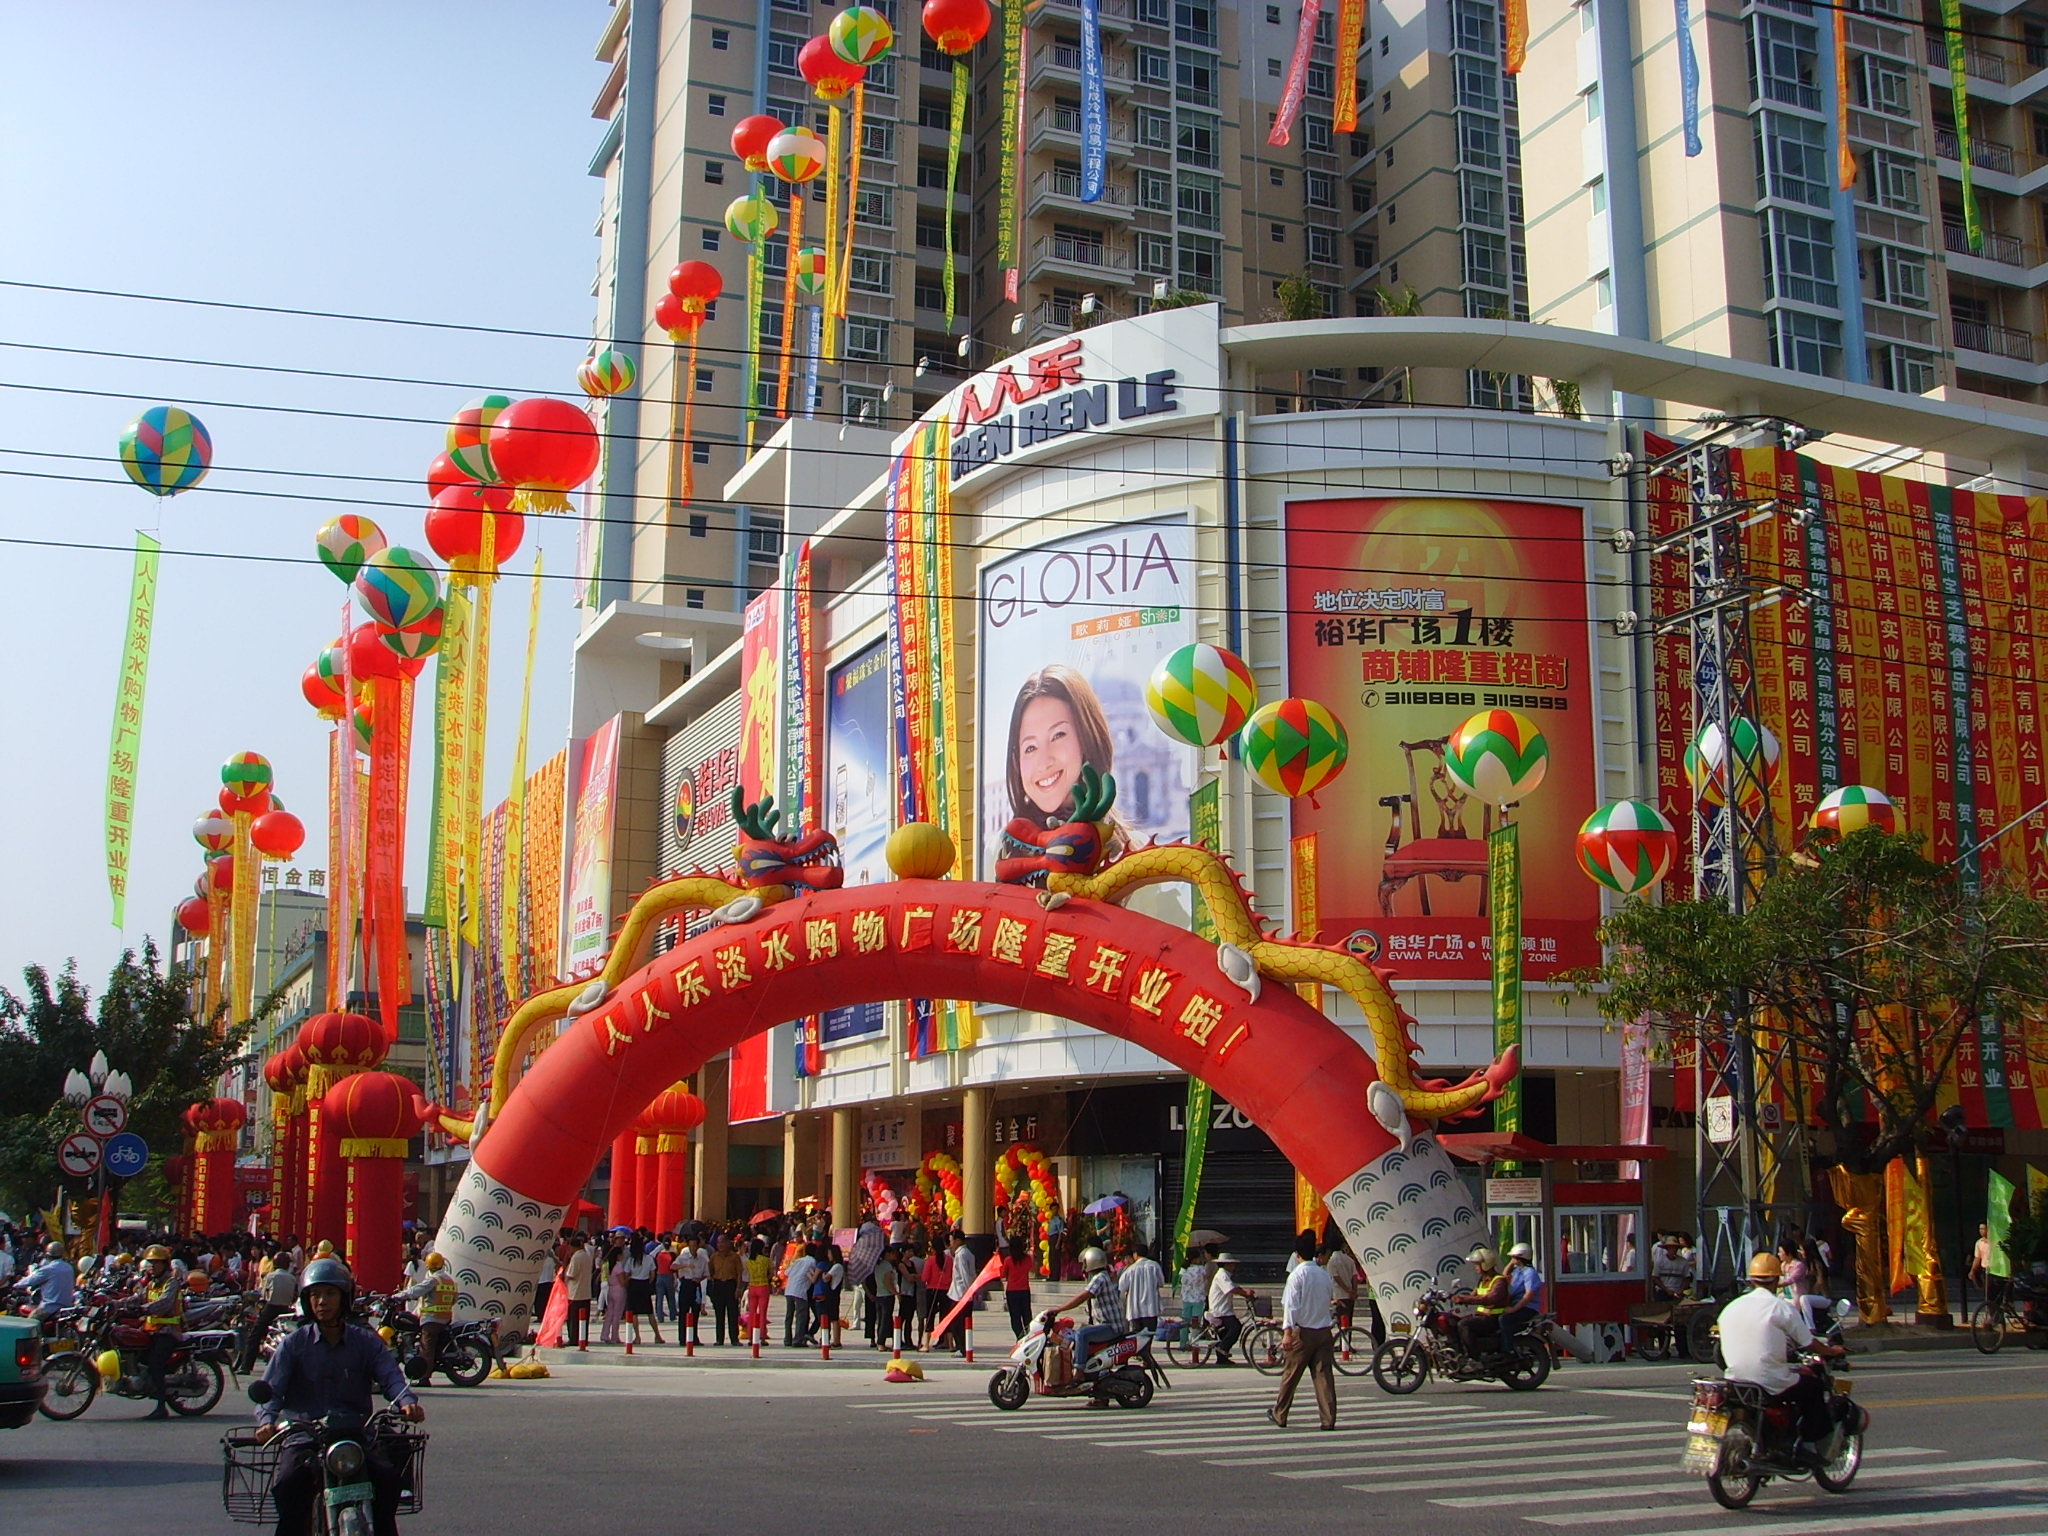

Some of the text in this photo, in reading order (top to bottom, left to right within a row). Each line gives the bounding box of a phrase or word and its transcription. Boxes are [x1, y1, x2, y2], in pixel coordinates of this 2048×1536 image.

[952, 339, 1081, 437] 人人乐
[951, 369, 1178, 481] REN REN LE
[988, 532, 1180, 628] GLORIA
[1313, 588, 1445, 612] 地位决定财富
[1075, 614, 1132, 637] 歌莉娅
[1314, 607, 1515, 647] 裕华广场1楼
[1361, 649, 1568, 690] 商铺隆重招商
[1385, 691, 1568, 710] 3118888 3119999
[108, 560, 155, 899] 人人乐淡水购物广场隆重开业啦
[1388, 933, 1463, 950] 裕华广场
[1388, 950, 1557, 963] EVWA PLAZA ZONE
[605, 906, 1246, 1058] 人人乐淡水购物广场隆重开业啦！
